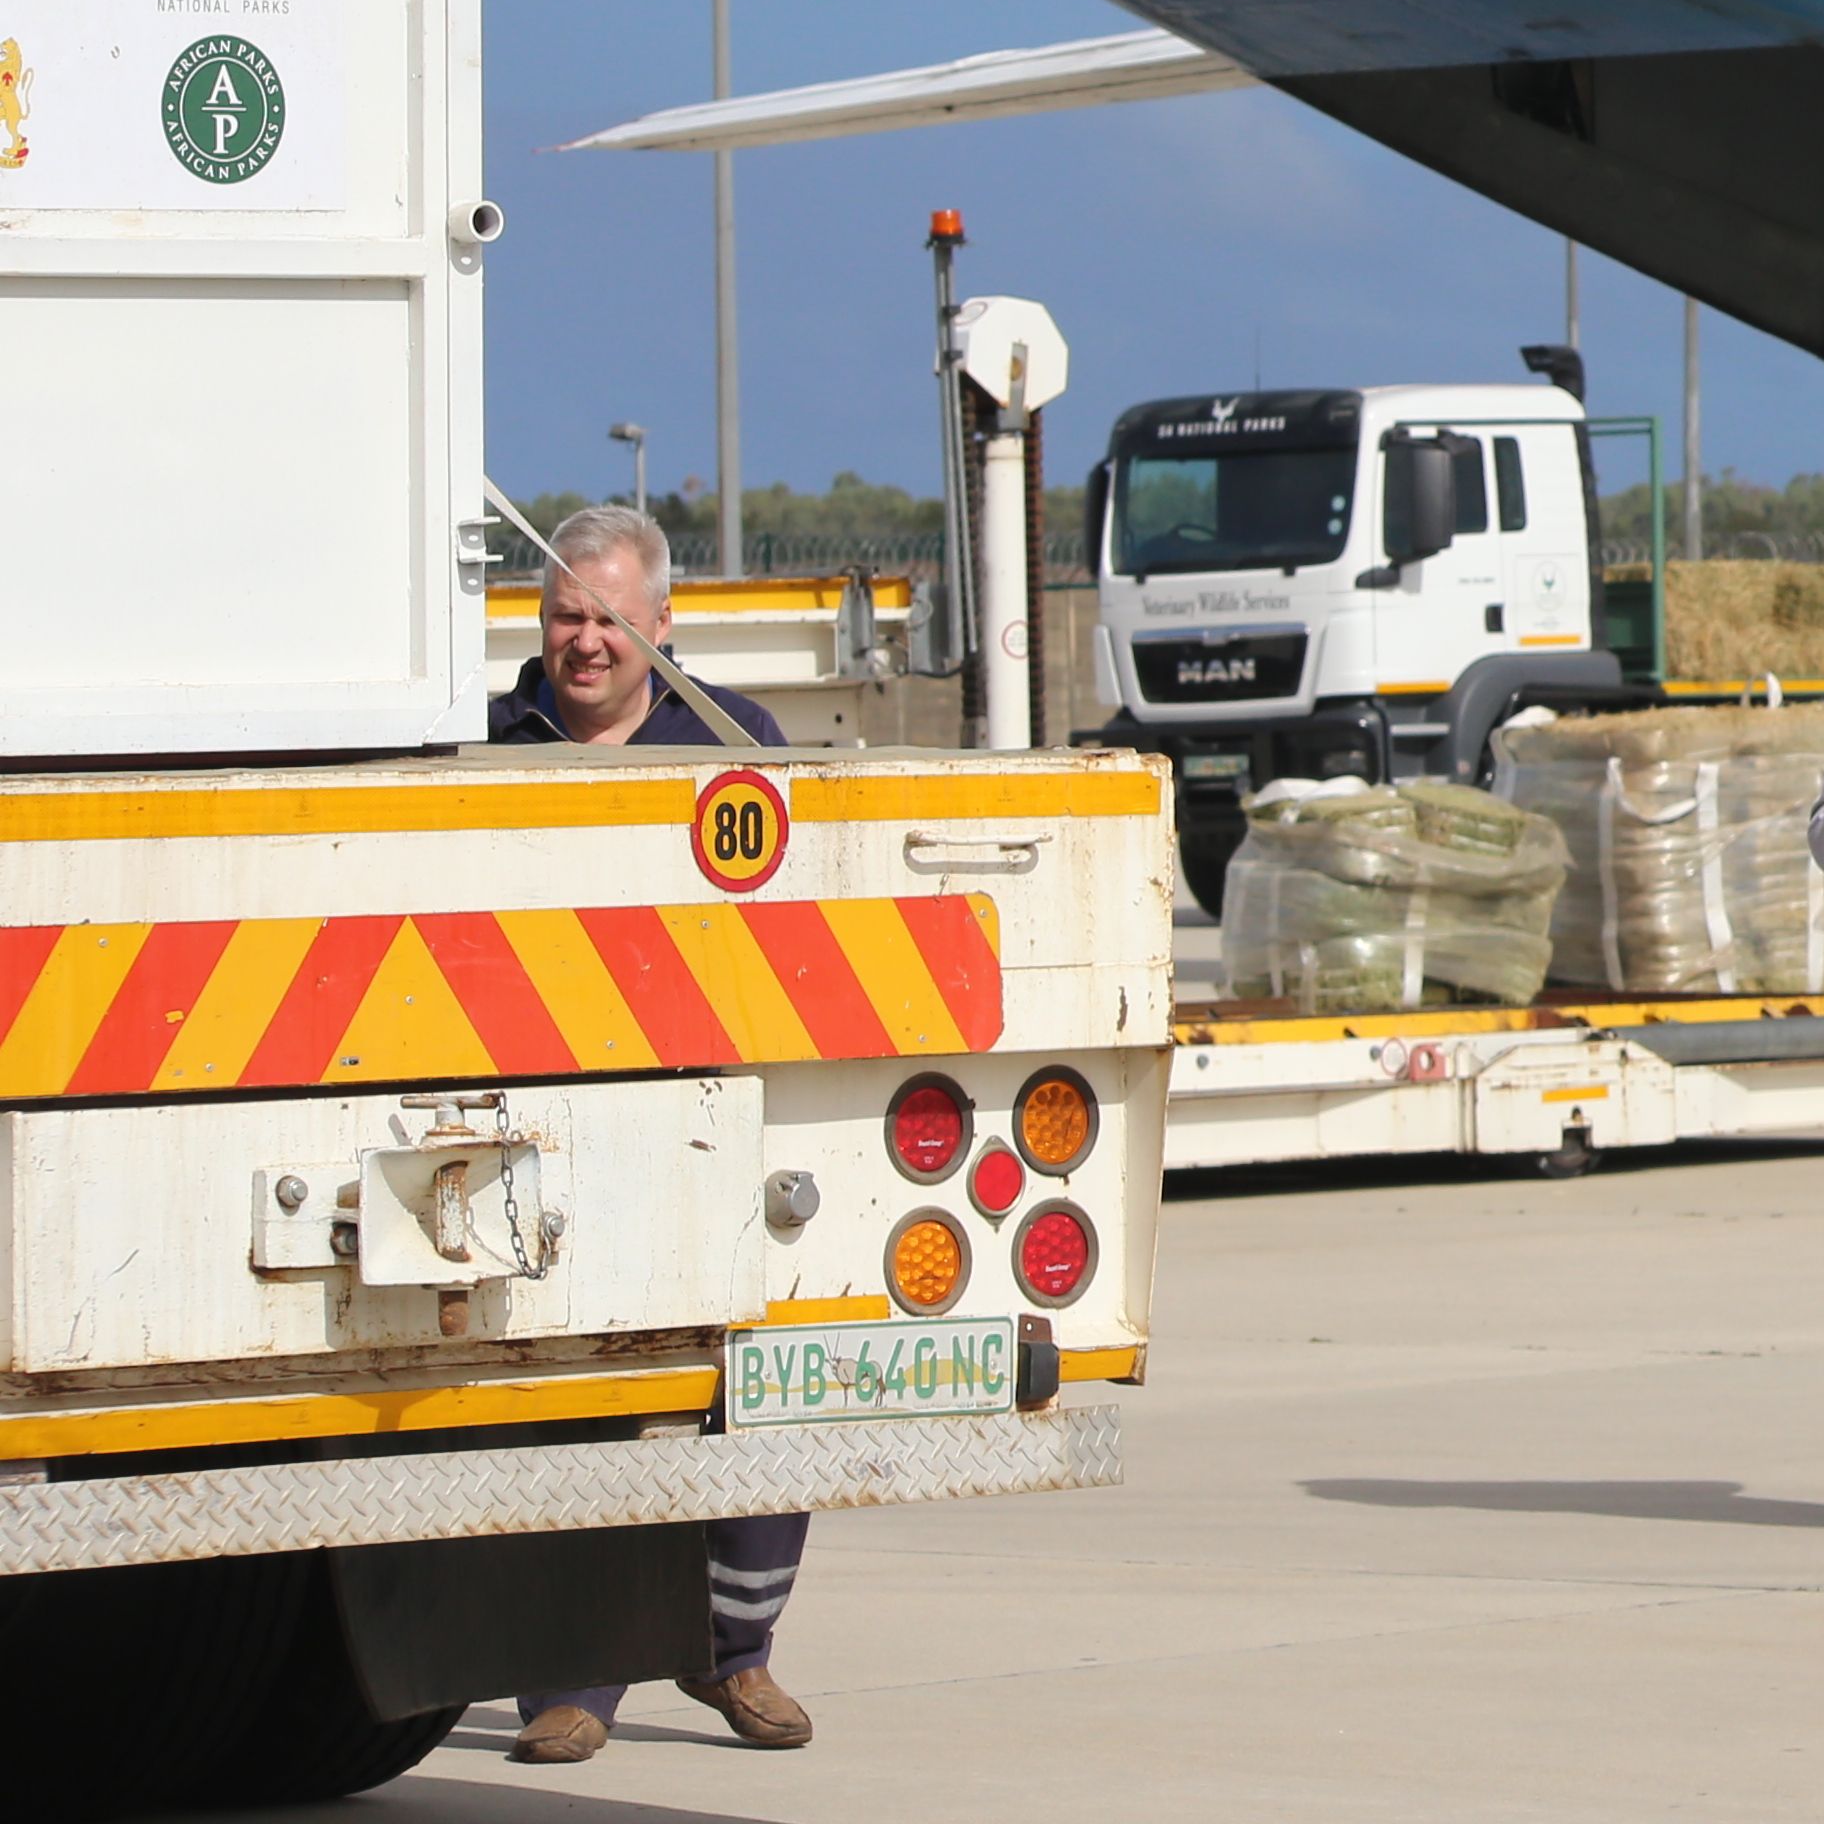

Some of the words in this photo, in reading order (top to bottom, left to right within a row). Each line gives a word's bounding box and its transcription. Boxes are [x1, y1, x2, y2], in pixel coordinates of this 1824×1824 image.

[157, 0, 230, 13] NATIONAL
[243, 0, 290, 15] PARKS
[169, 40, 231, 92] AFRICAN
[237, 44, 279, 94] PARKS
[206, 64, 242, 104] A
[167, 121, 229, 179] AFRICAN
[237, 123, 279, 175] PARKS
[212, 114, 239, 154] P
[1178, 659, 1256, 685] MAN
[715, 801, 763, 860] 80
[742, 1342, 827, 1409] BYB
[854, 1337, 938, 1402] 640
[951, 1333, 1004, 1398] NC
